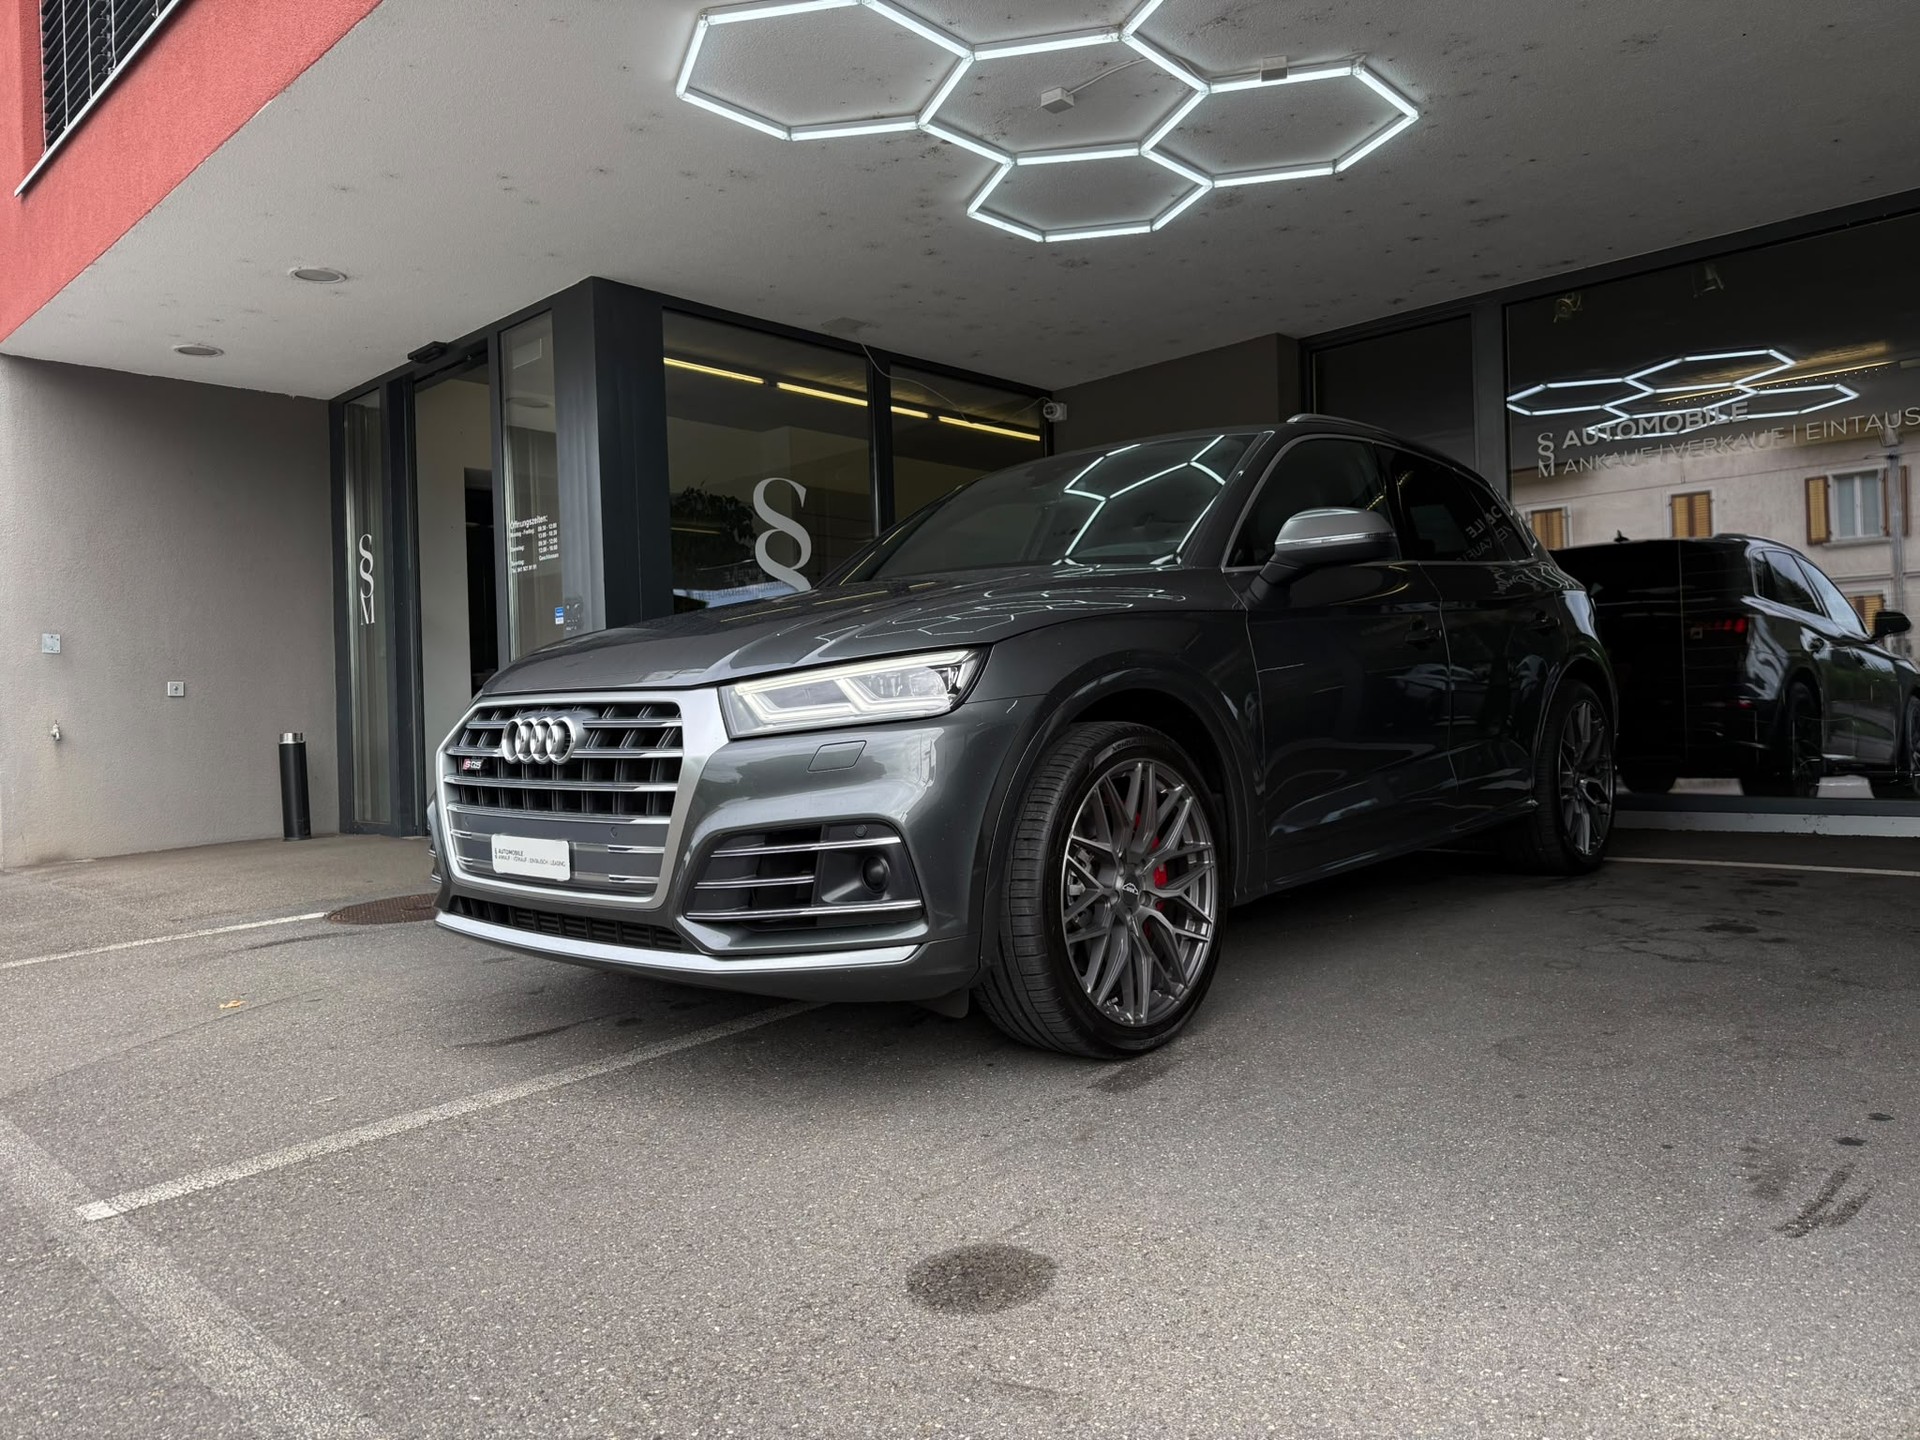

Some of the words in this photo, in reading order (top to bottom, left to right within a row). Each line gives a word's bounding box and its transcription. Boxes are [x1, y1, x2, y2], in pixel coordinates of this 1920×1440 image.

[1562, 400, 1749, 449] AUTOMOBILE
[1563, 446, 1653, 476] ANKAUF
[1669, 426, 1785, 460] VERKAUF
